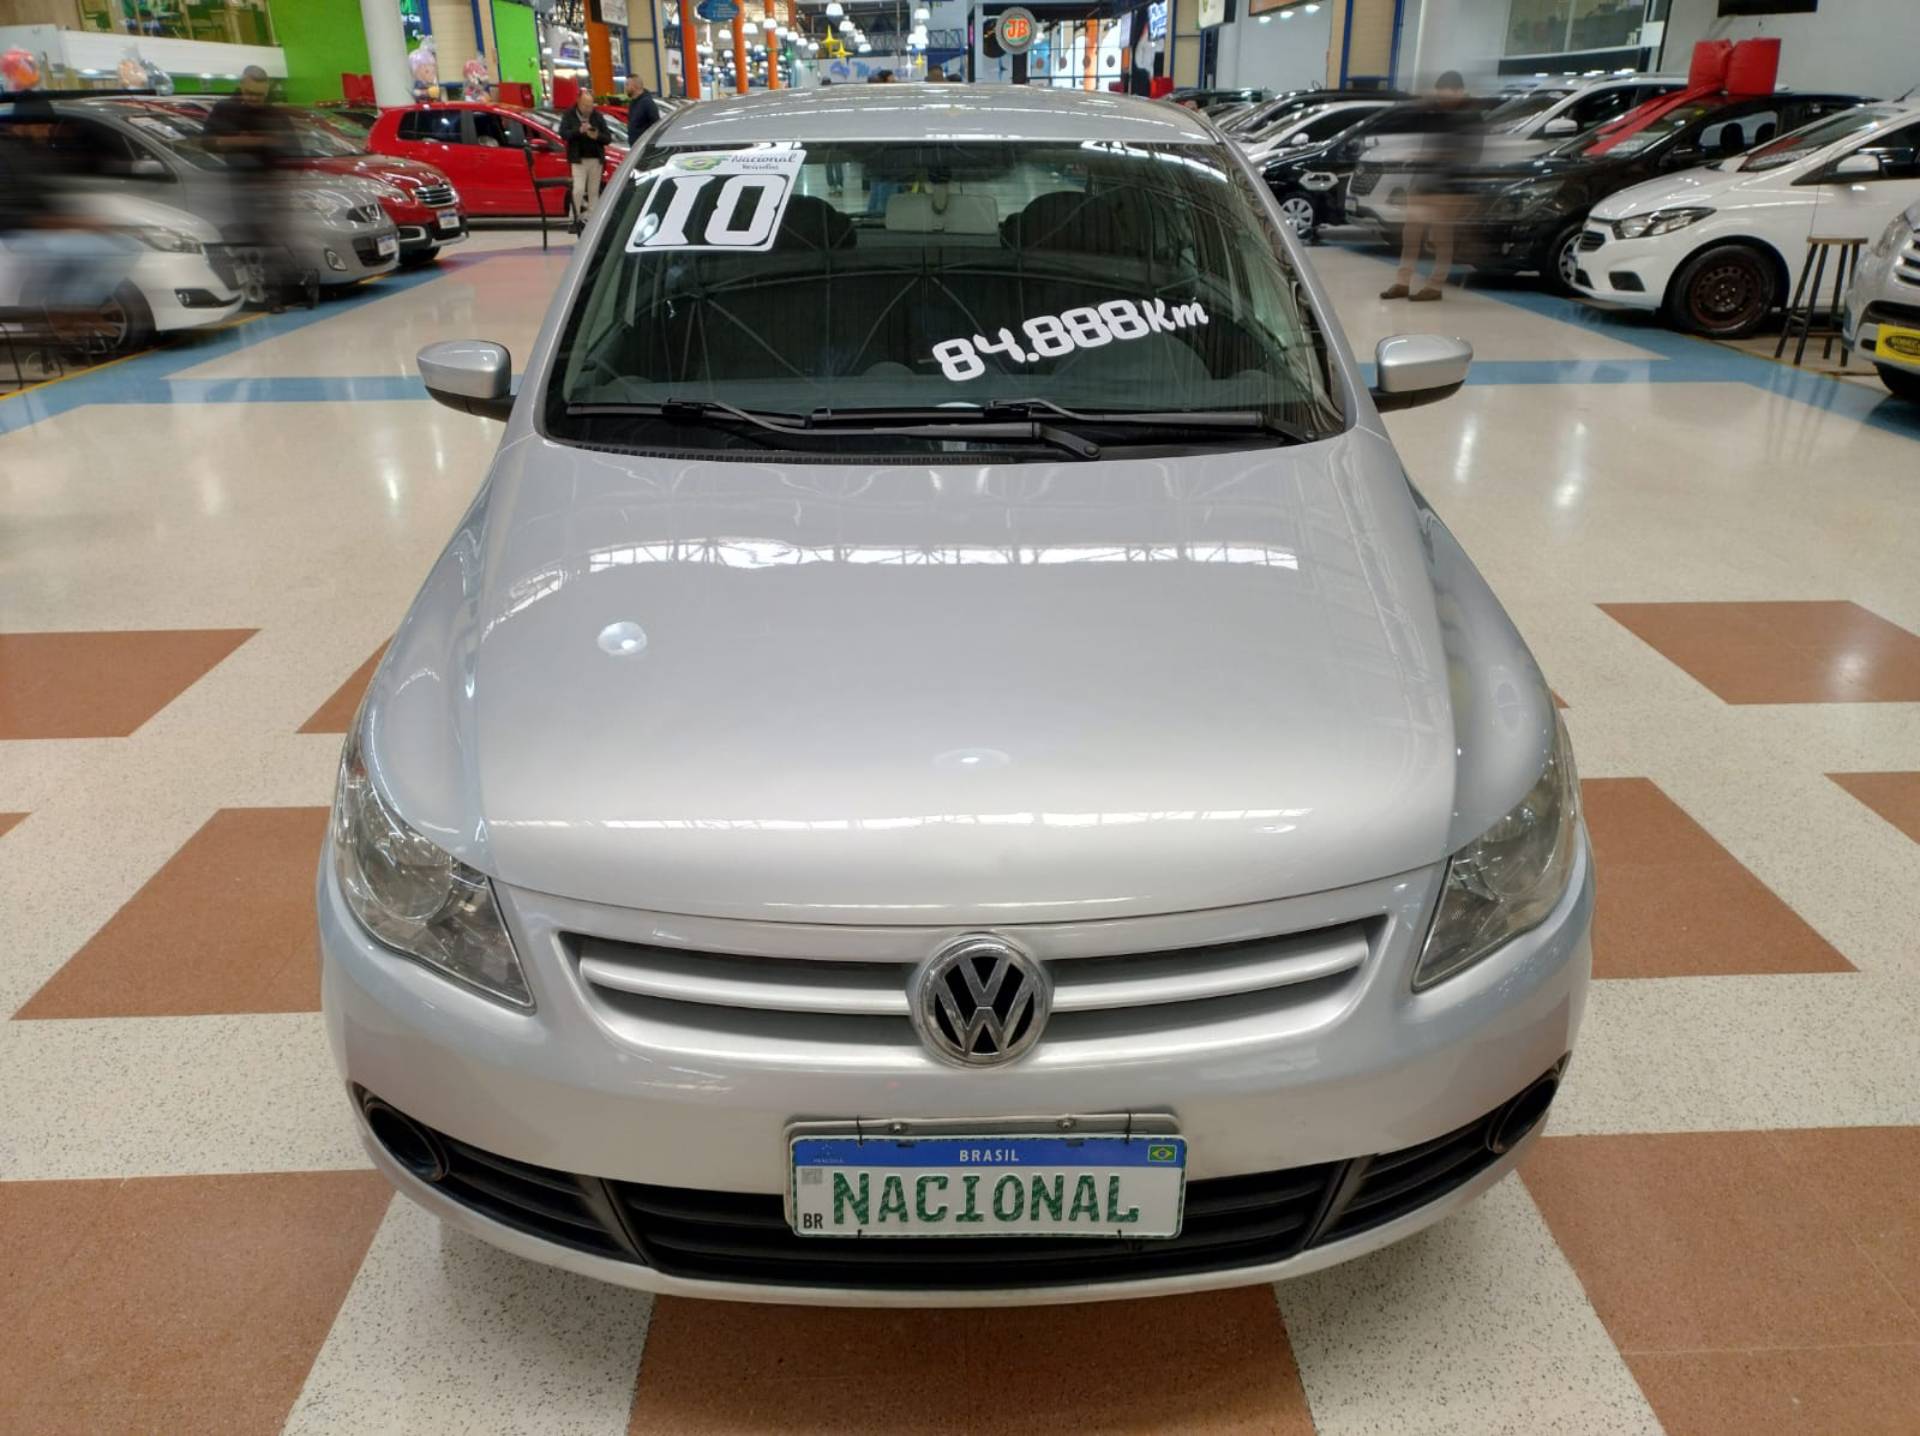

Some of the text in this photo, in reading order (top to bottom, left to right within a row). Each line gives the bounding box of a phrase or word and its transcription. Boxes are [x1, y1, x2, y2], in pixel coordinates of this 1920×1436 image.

[1007, 18, 1028, 38] JB
[730, 153, 797, 163] Nacional
[643, 174, 787, 246] 10
[959, 1148, 1020, 1163] BRASIL
[832, 1171, 1140, 1225] NACIONAL
[803, 1213, 823, 1229] BR
